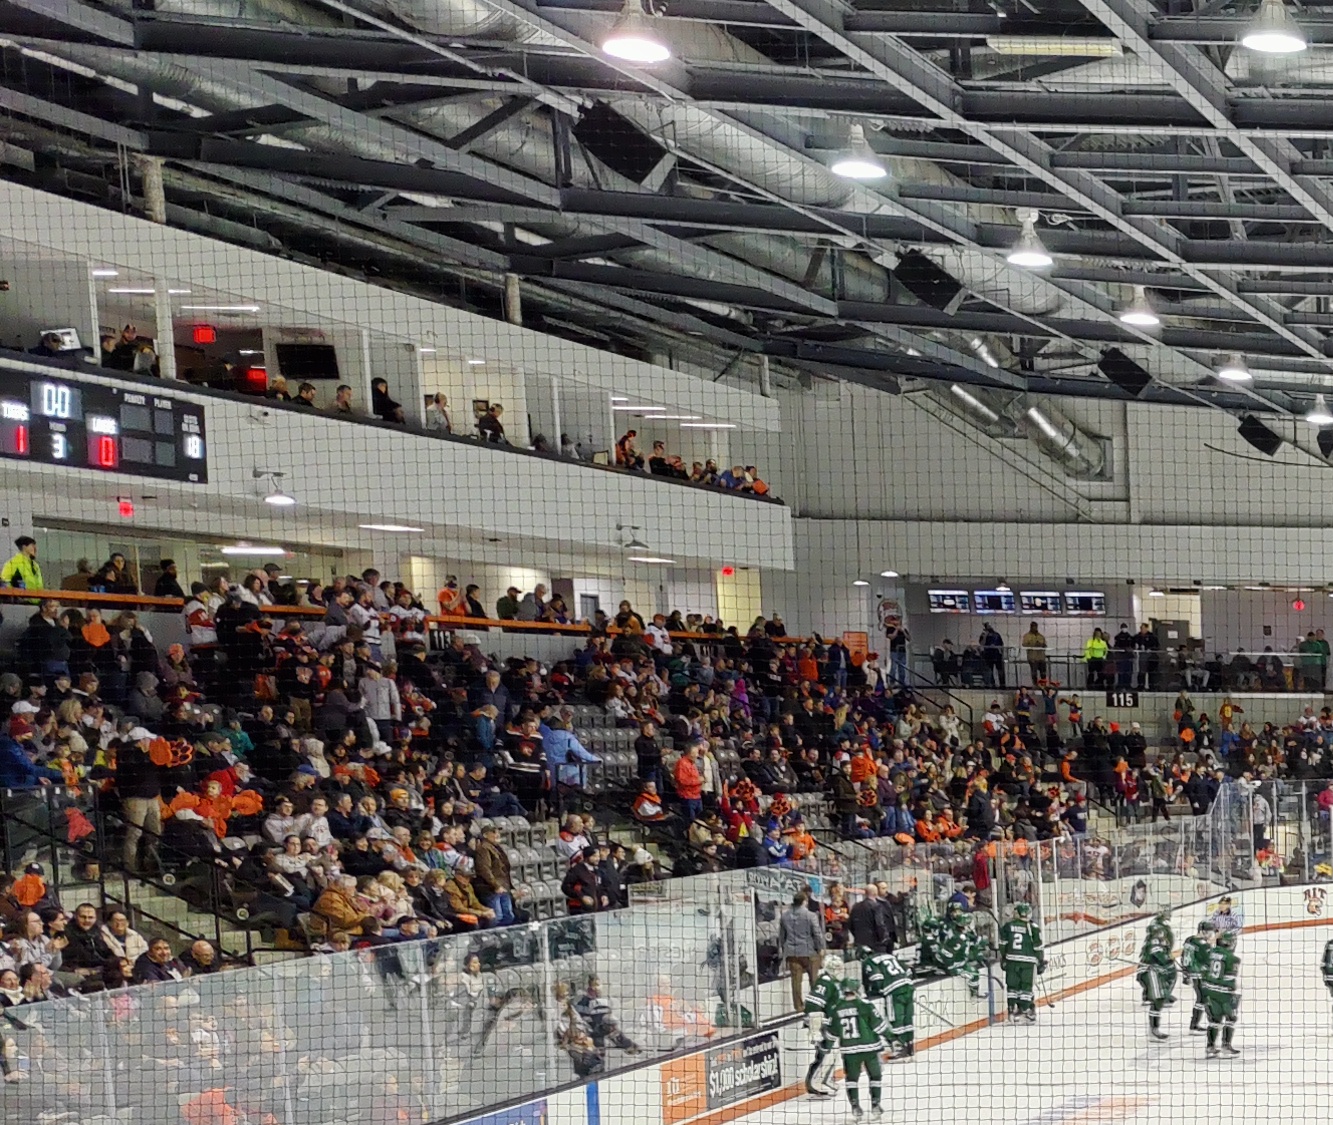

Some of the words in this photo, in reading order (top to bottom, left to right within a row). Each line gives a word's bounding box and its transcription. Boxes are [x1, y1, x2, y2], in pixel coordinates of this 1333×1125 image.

[51, 432, 66, 459] 3
[99, 435, 114, 466] 0
[1112, 694, 1133, 707] 115
[1013, 933, 1023, 949] 2
[840, 1016, 860, 1039] 21
